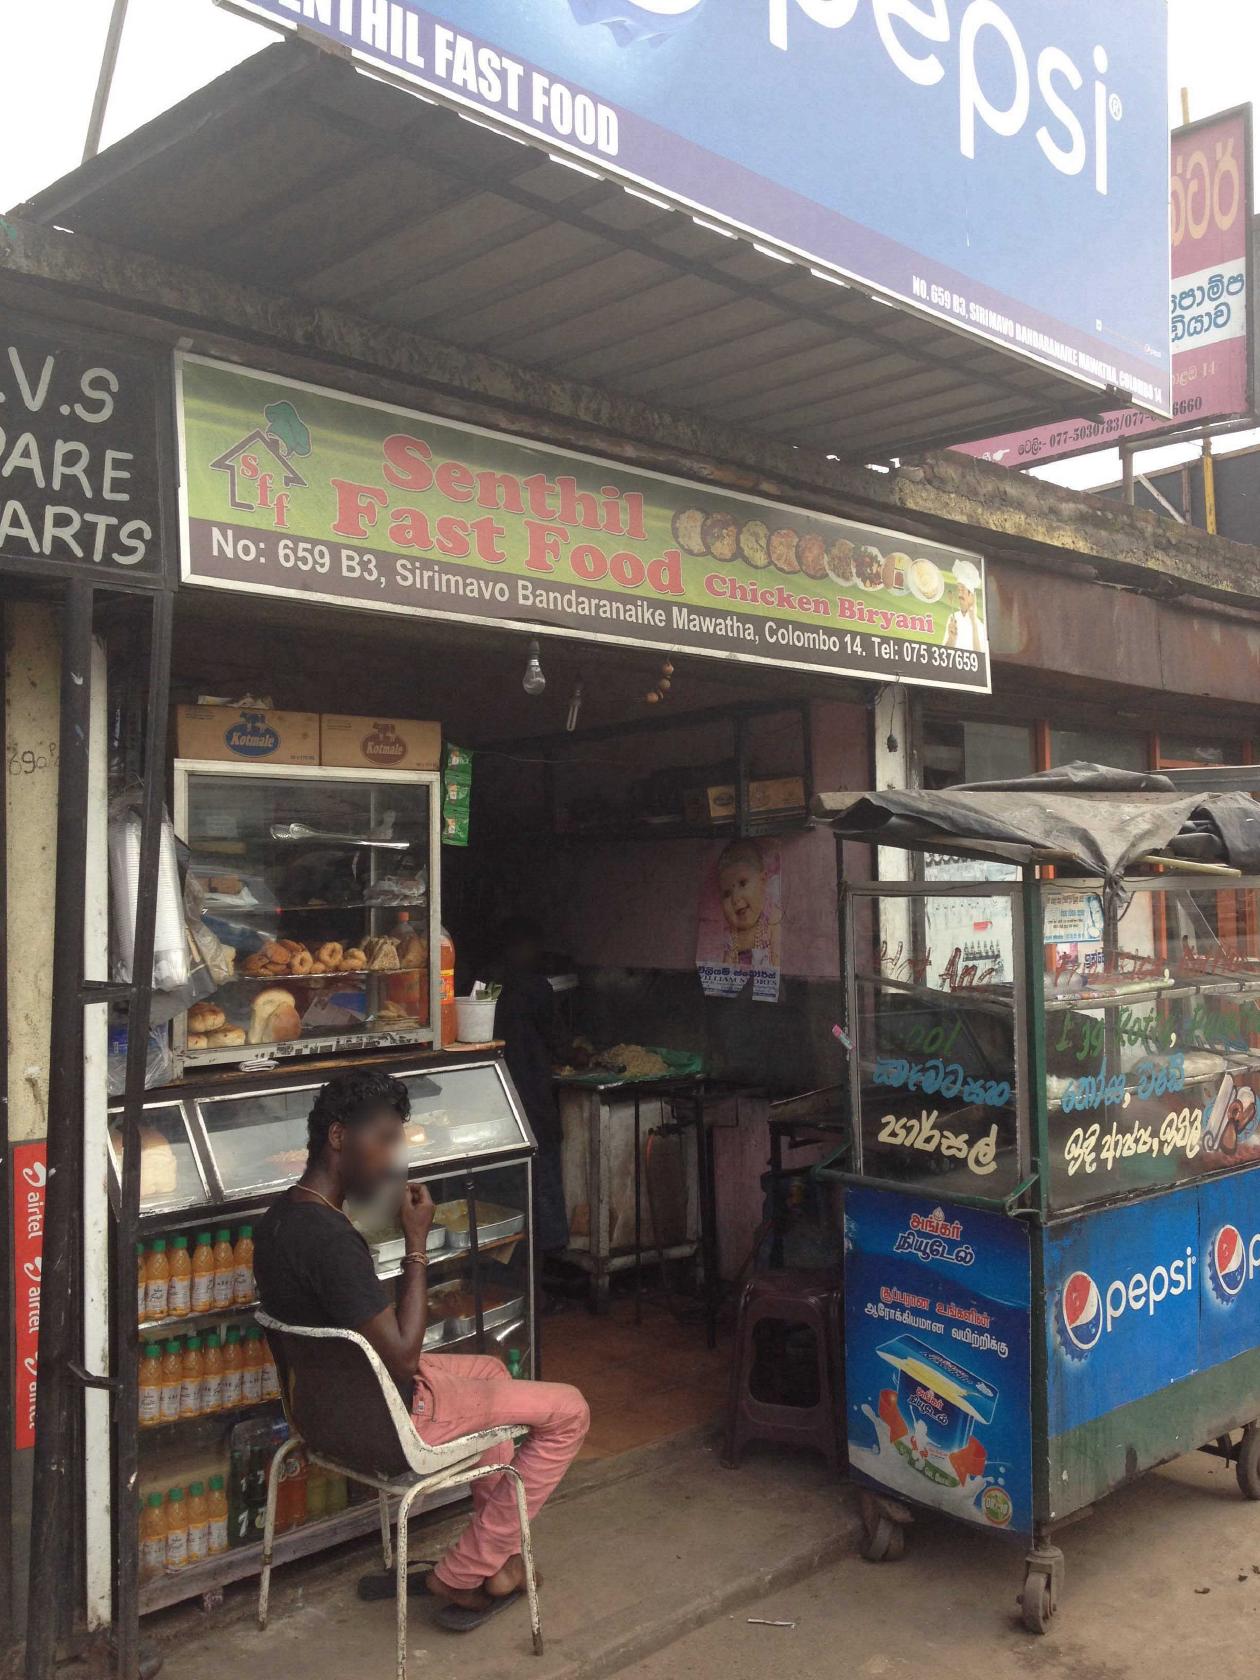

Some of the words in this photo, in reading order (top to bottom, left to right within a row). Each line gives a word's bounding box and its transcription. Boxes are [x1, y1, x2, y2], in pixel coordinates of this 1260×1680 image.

[434, 24, 524, 111] FAST
[532, 72, 619, 156] FOOD
[912, 275, 929, 301] NO.
[930, 284, 951, 310] 659
[952, 294, 969, 320] B3,
[969, 301, 1014, 338] SIRIMAVO
[0, 427, 134, 501] ARE
[382, 433, 648, 541] Senthil
[330, 478, 508, 564] Fast
[524, 518, 685, 596] Food
[211, 527, 266, 564] No:
[278, 538, 330, 574] 659
[341, 548, 386, 588] B3,
[395, 558, 510, 603] Sirimavo
[517, 585, 667, 628] Bandaranaike
[672, 608, 759, 644] Mawatha,
[765, 620, 839, 652] Colombo
[844, 633, 866, 657] 14.
[871, 637, 899, 660] Tel:
[904, 641, 928, 664] 075
[931, 647, 979, 672] 337659
[704, 573, 830, 615] Chicken
[838, 597, 935, 634] Biryani
[230, 731, 275, 747] Kotmale
[366, 741, 404, 755] Kotmale
[27, 1191, 44, 1239] airtel
[1106, 1246, 1192, 1333] pepsi
